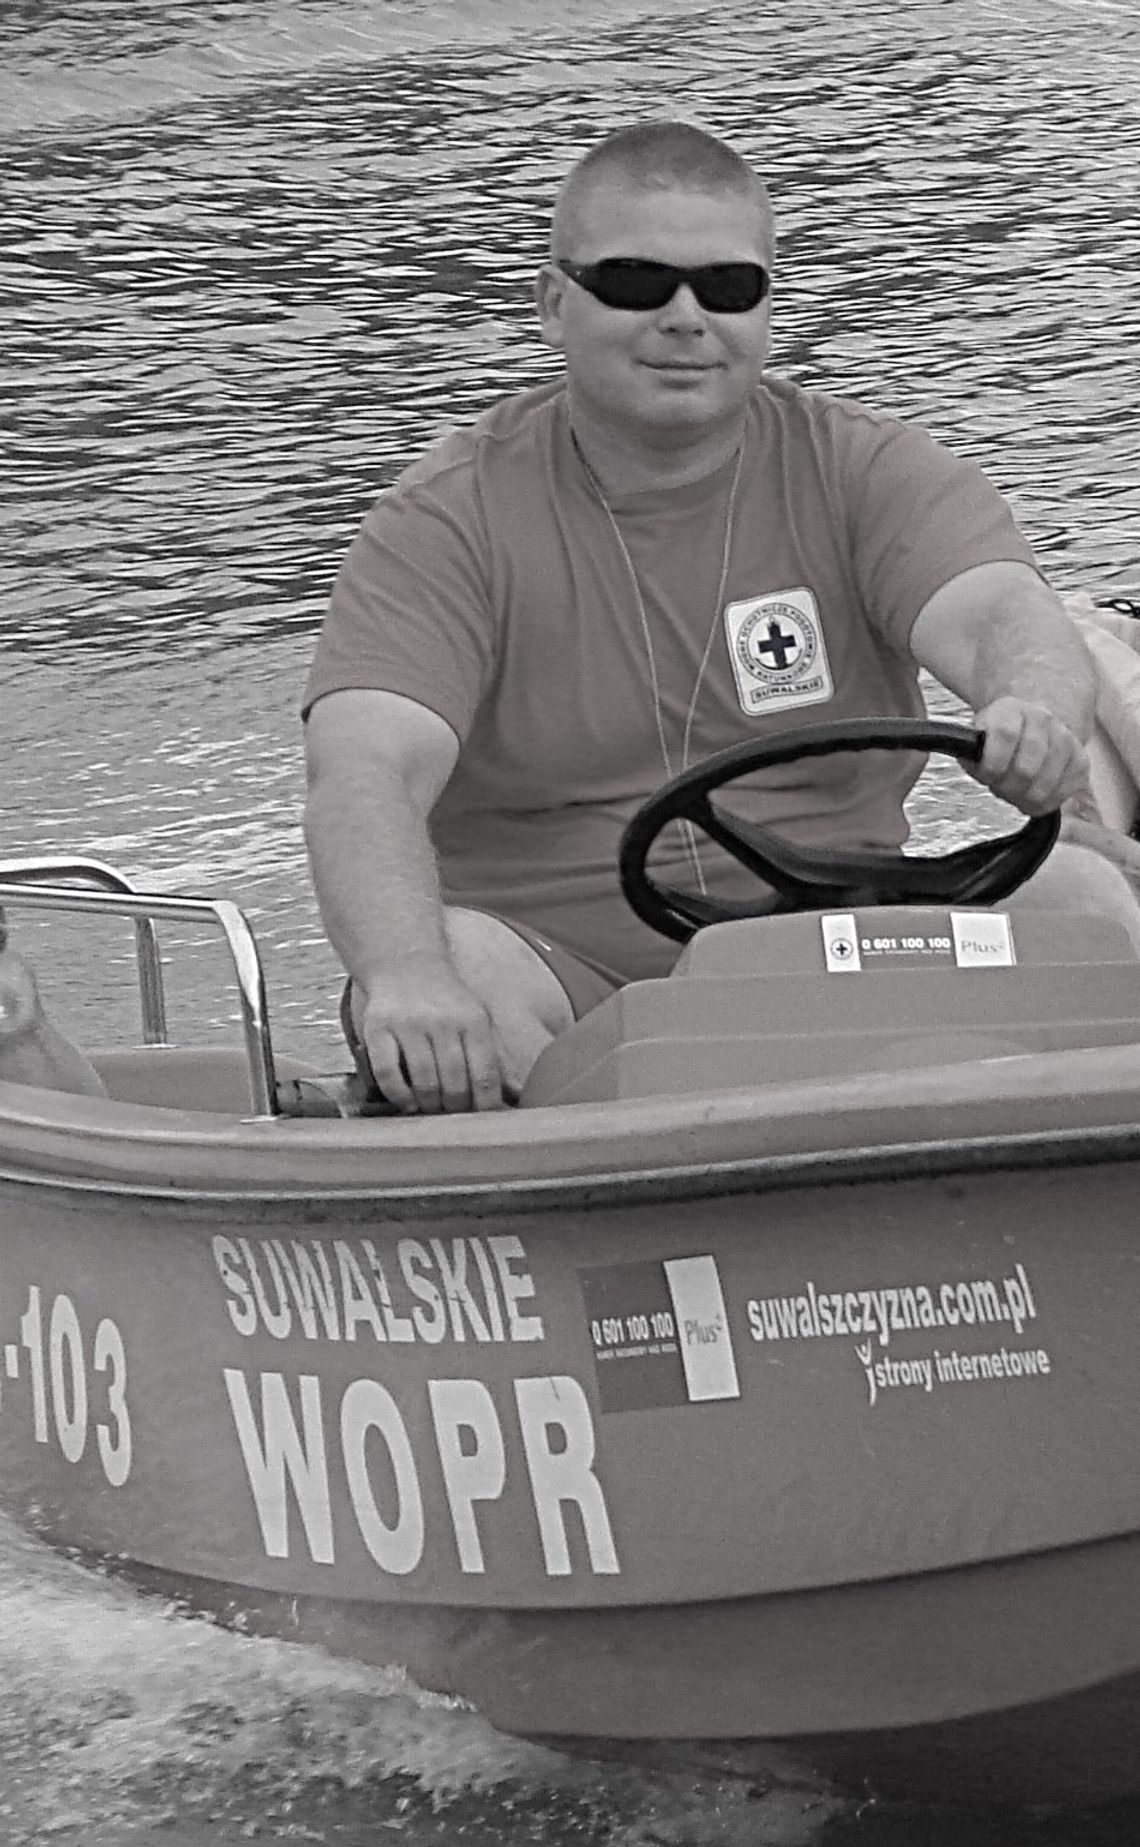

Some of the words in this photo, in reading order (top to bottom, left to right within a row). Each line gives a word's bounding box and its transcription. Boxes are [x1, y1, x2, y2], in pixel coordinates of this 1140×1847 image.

[755, 681, 820, 698] SUWALSKIE
[861, 939, 871, 949] 0
[874, 938, 897, 948] 601
[900, 938, 924, 948] 100
[928, 937, 950, 948] 100
[212, 1235, 544, 1343] SUWALSKIE
[748, 1264, 1036, 1345] suwalszczyzna.com.pl
[591, 1320, 602, 1345] 0
[602, 1317, 625, 1344] 601
[626, 1315, 650, 1340] 100
[651, 1312, 675, 1338] 100
[876, 1356, 933, 1392] strony
[934, 1347, 1051, 1383] internetowe
[223, 1368, 621, 1576] WOPR
